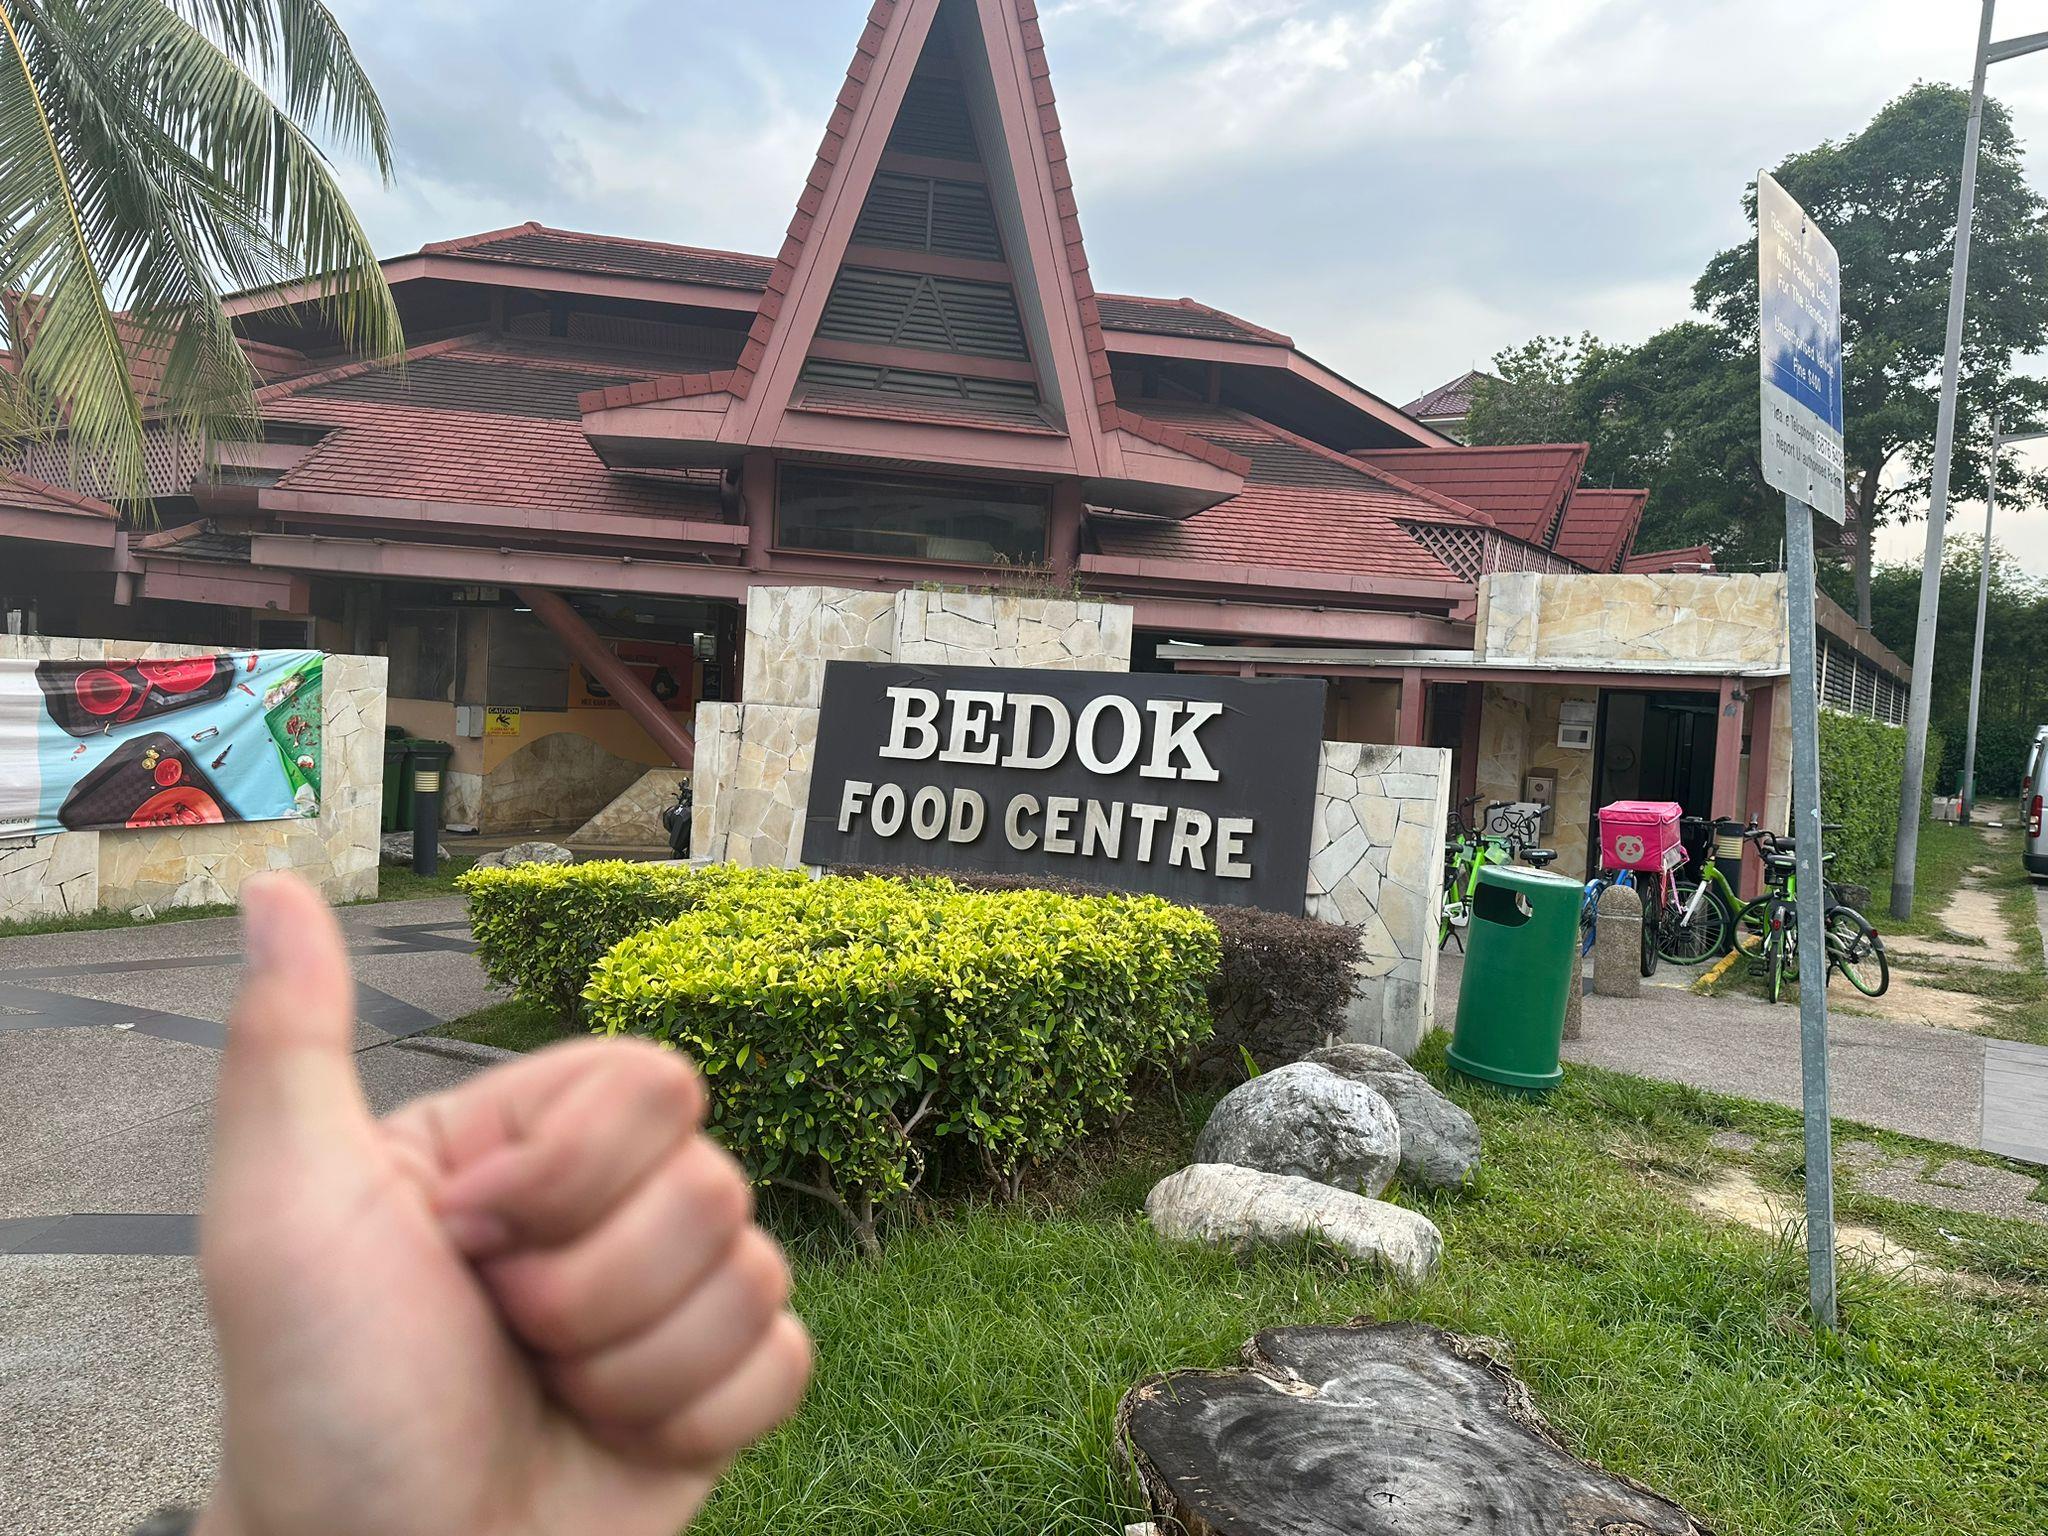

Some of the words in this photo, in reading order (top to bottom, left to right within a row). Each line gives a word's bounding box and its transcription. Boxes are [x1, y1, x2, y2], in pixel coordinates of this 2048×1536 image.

[1777, 243, 1791, 271] With
[1793, 259, 1815, 298] Parking
[1777, 272, 1788, 295] For
[1791, 283, 1804, 309] The
[1793, 355, 1806, 381] Fine
[1768, 400, 1789, 428] leae
[1776, 433, 1796, 458] Report
[1796, 446, 1827, 479] Uauthorised
[879, 686, 1222, 782] BEDOK
[0, 817, 30, 825] CLEAN
[837, 779, 985, 844] FOOD
[1005, 793, 1254, 879] CENTRE
